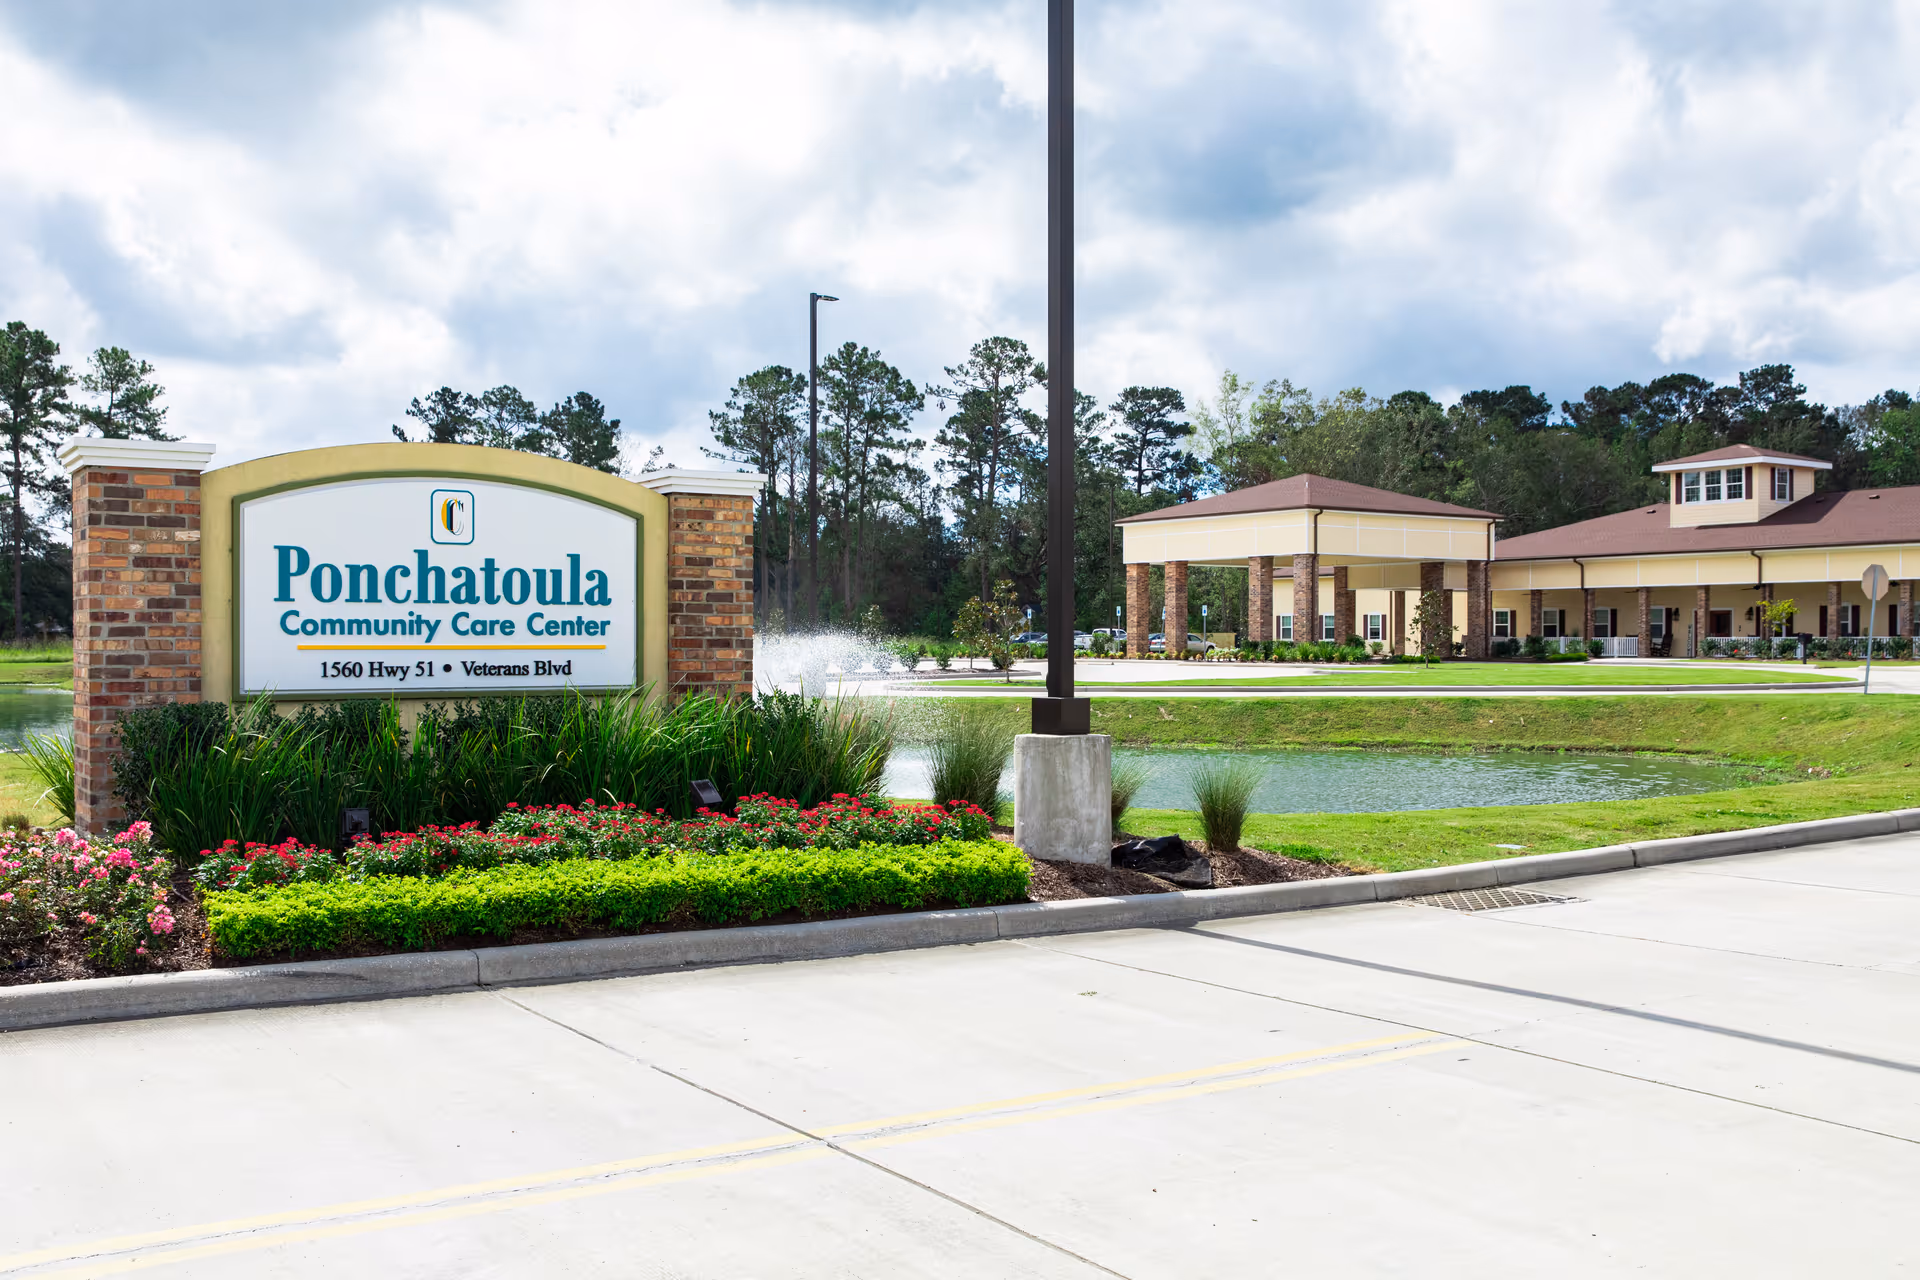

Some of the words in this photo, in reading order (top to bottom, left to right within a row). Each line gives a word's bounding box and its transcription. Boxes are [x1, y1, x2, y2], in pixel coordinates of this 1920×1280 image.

[273, 545, 612, 606] Ponchatoula
[279, 610, 441, 643] Community
[451, 612, 515, 636] Care
[526, 612, 611, 637] Center
[320, 661, 363, 679] 1560
[368, 661, 410, 681] Hwy
[415, 661, 435, 678] 51
[461, 660, 530, 677] Veterans
[534, 659, 573, 677] Blvd
